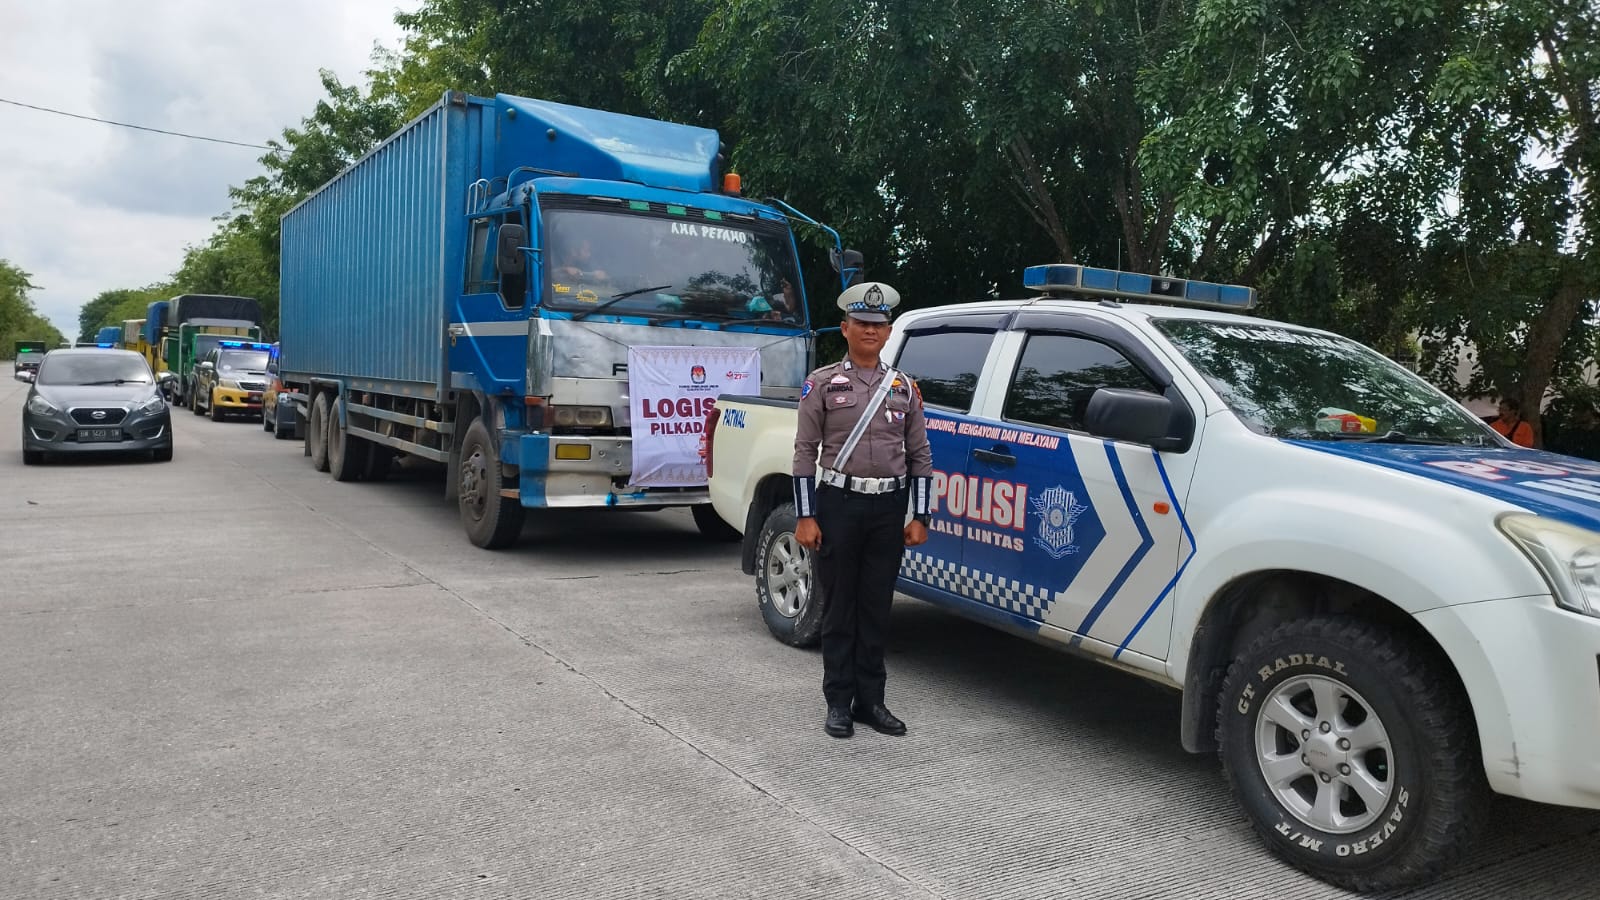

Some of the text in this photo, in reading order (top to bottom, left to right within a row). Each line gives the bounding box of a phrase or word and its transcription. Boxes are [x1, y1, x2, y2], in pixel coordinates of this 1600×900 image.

[642, 397, 717, 419] LOGIS
[722, 408, 748, 429] PATWAL
[650, 421, 706, 436] PILKAD
[924, 417, 1060, 450] LINDUNGI, MENGAYOMI DAN MELAYANI
[929, 469, 1028, 532] POLISI
[929, 518, 964, 537] LALU
[967, 525, 1025, 552] LINTAS
[1237, 653, 1349, 715] GT RADIAL
[1274, 785, 1409, 857] SAVERO M/T
